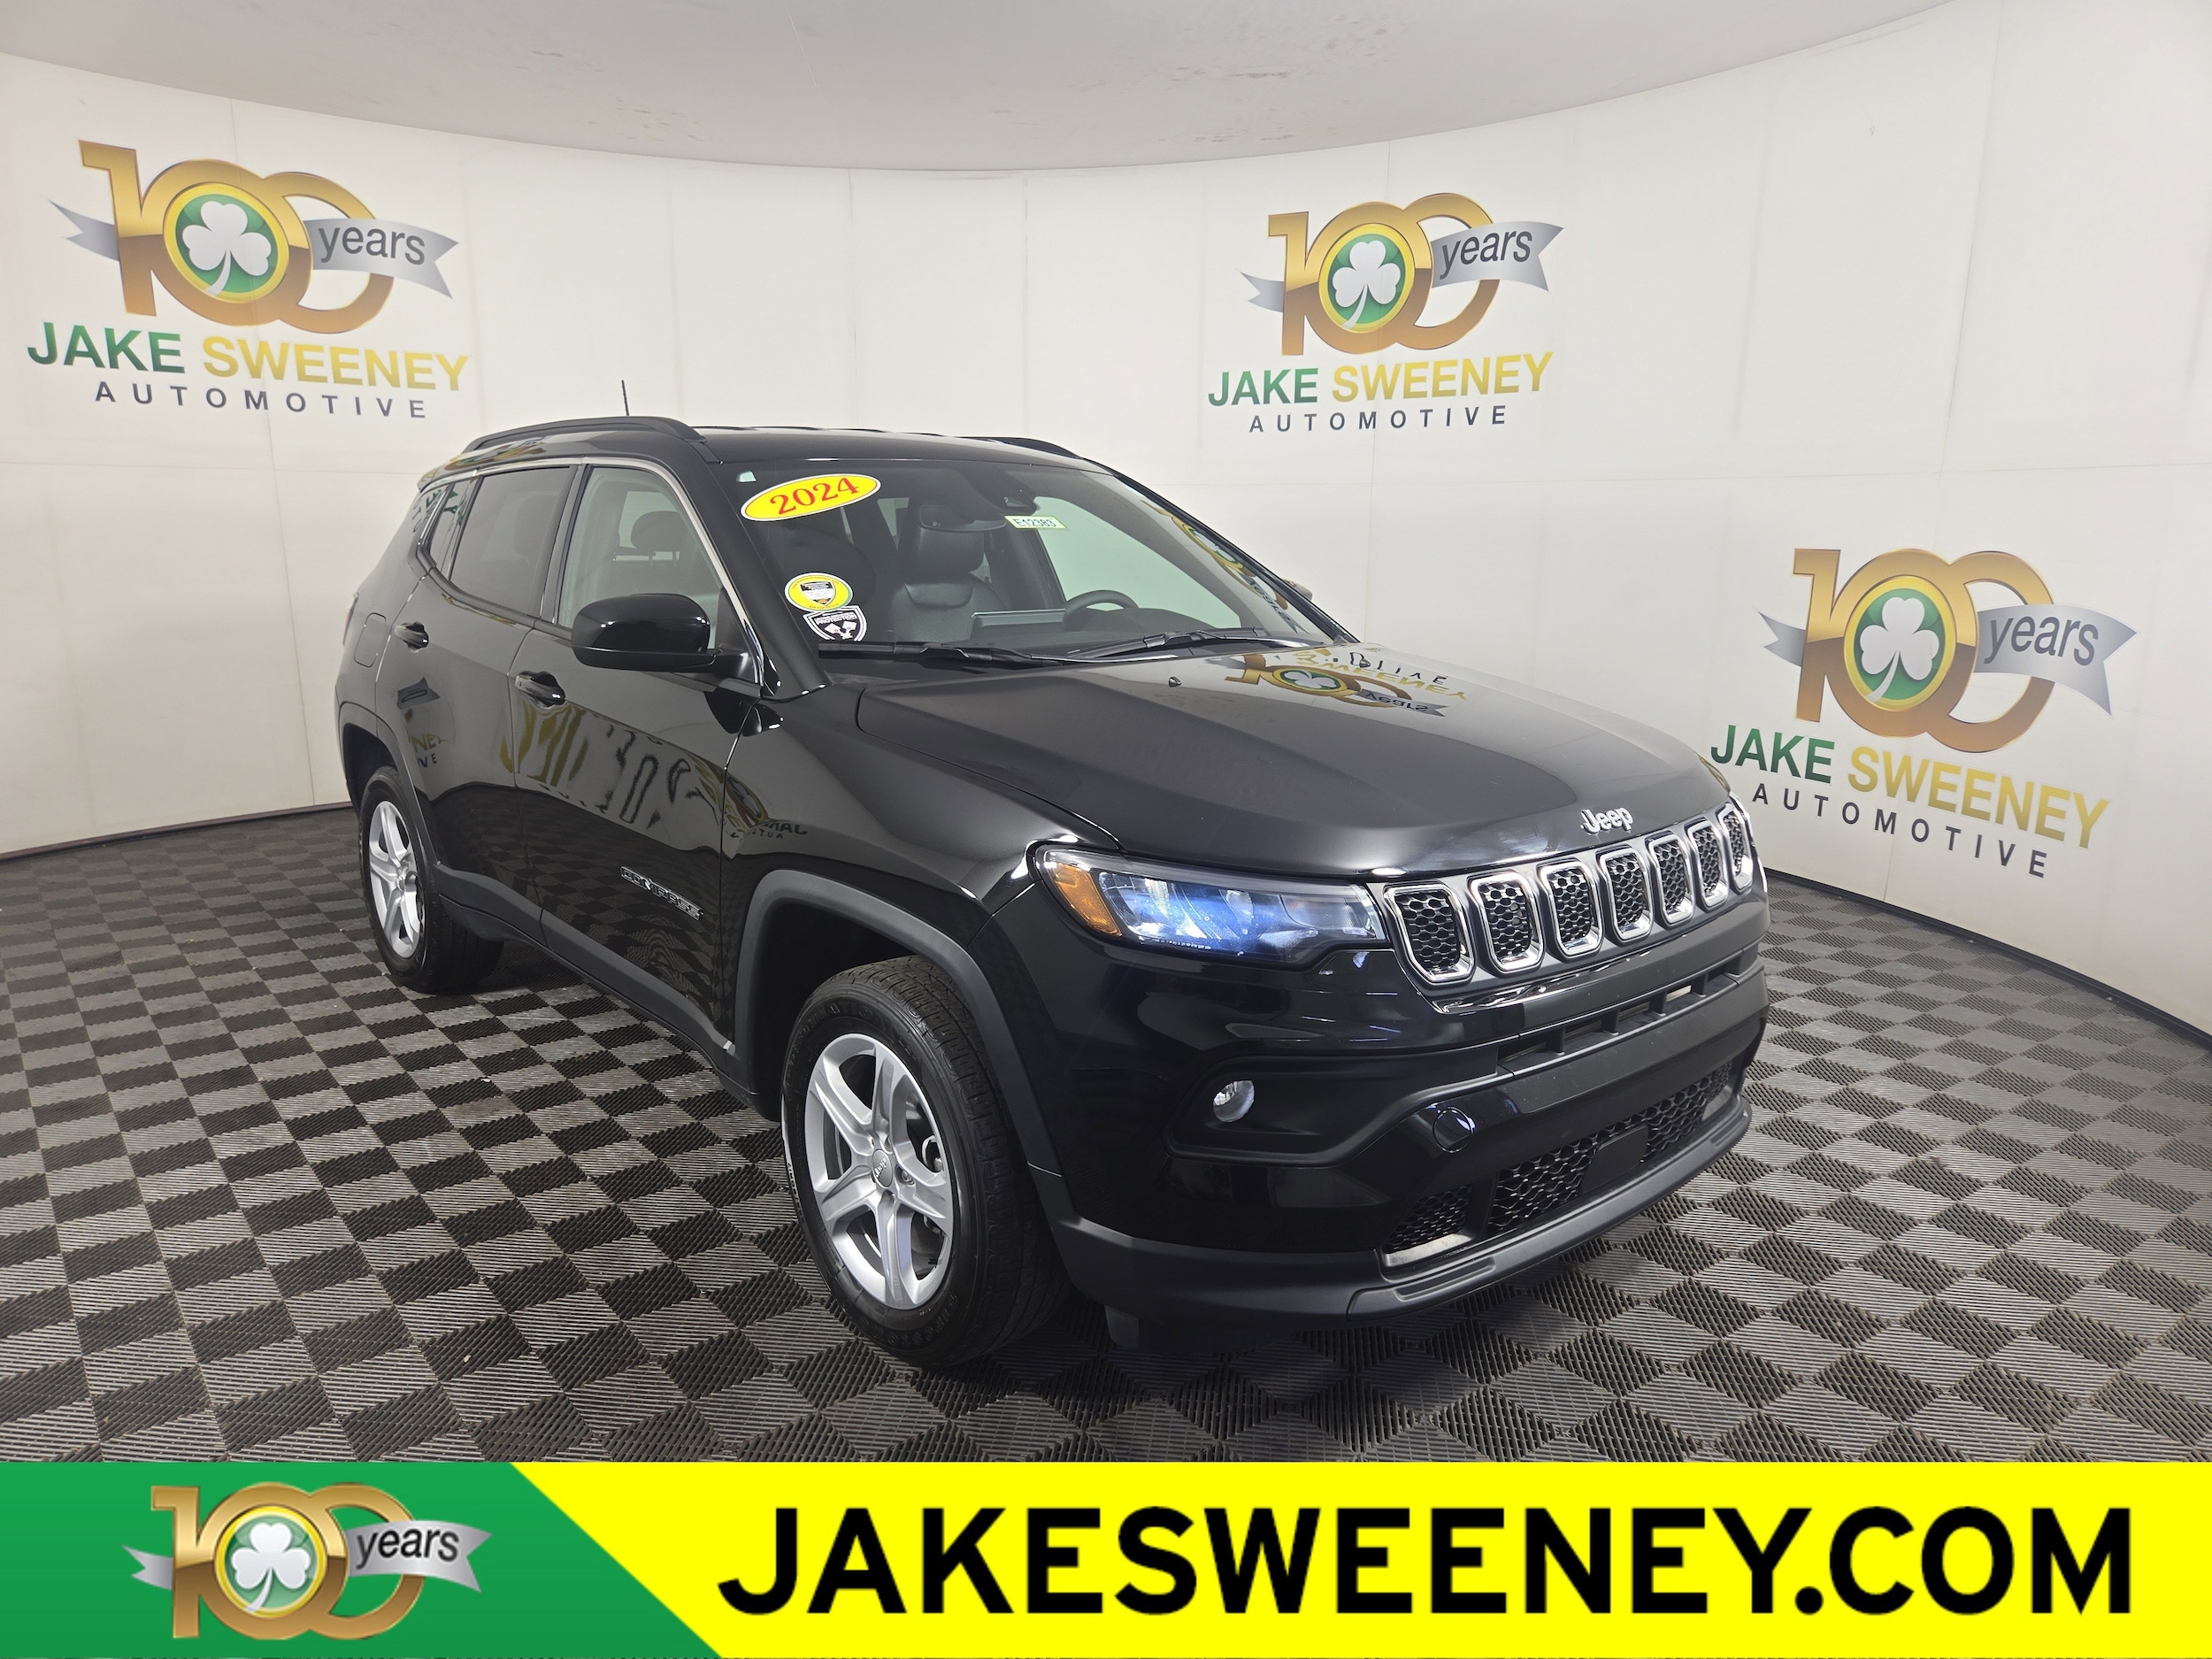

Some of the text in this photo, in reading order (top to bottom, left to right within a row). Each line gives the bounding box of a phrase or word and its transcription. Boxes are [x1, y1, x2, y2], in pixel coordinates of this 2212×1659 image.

[79, 139, 426, 334] 100 years
[1268, 192, 1533, 356] 100 years
[27, 321, 470, 392] JAKE SWEENEY
[1208, 350, 1555, 407] JAKE SWEENEY
[95, 380, 427, 419] AUTOMOTIVE
[1248, 404, 1507, 434] AUTOMOTIVE
[770, 477, 860, 515] 2024
[1792, 548, 2100, 754] 100 years
[1580, 806, 1634, 835] Jeep
[1710, 725, 2110, 850] JAKE SWEENEY
[1752, 782, 2048, 879] AUTOMOTIVE
